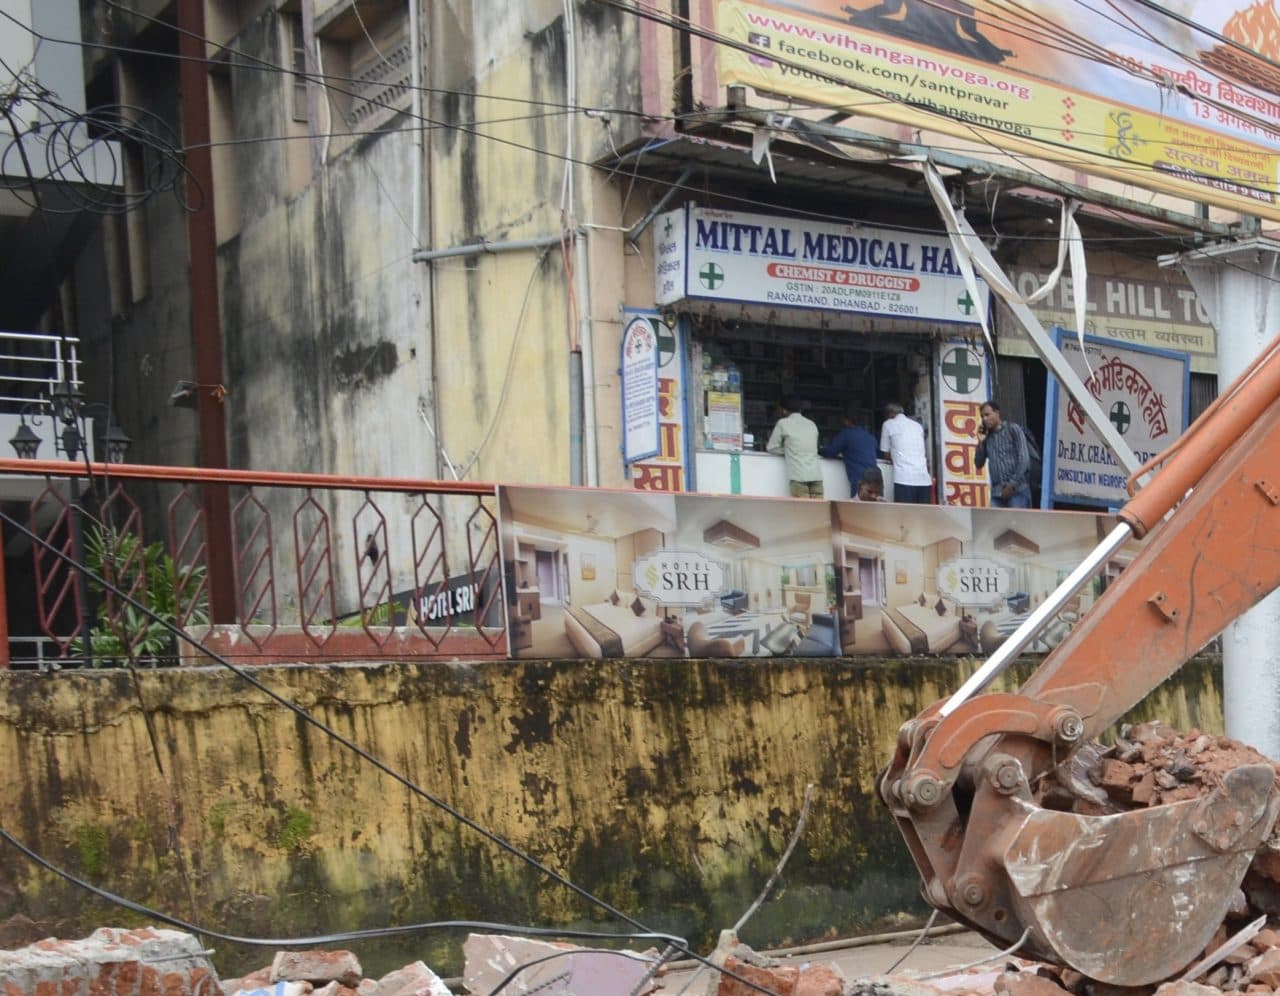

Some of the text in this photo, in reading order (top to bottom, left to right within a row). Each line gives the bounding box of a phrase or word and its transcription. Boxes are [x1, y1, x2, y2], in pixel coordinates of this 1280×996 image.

[747, 12, 1032, 100] www.vihangamyoga.org
[779, 40, 1009, 111] facebook.com/santpravar
[696, 218, 980, 277] MITTAL MEDICAL HA
[775, 264, 912, 290] CHEMIST & DRUGGIST
[786, 281, 814, 293] GSTIN
[1106, 280, 1171, 319] HILL
[661, 561, 712, 572] HOTEL
[662, 573, 711, 591] SRH
[960, 576, 999, 593] SRH
[420, 590, 454, 622] HOTEL
